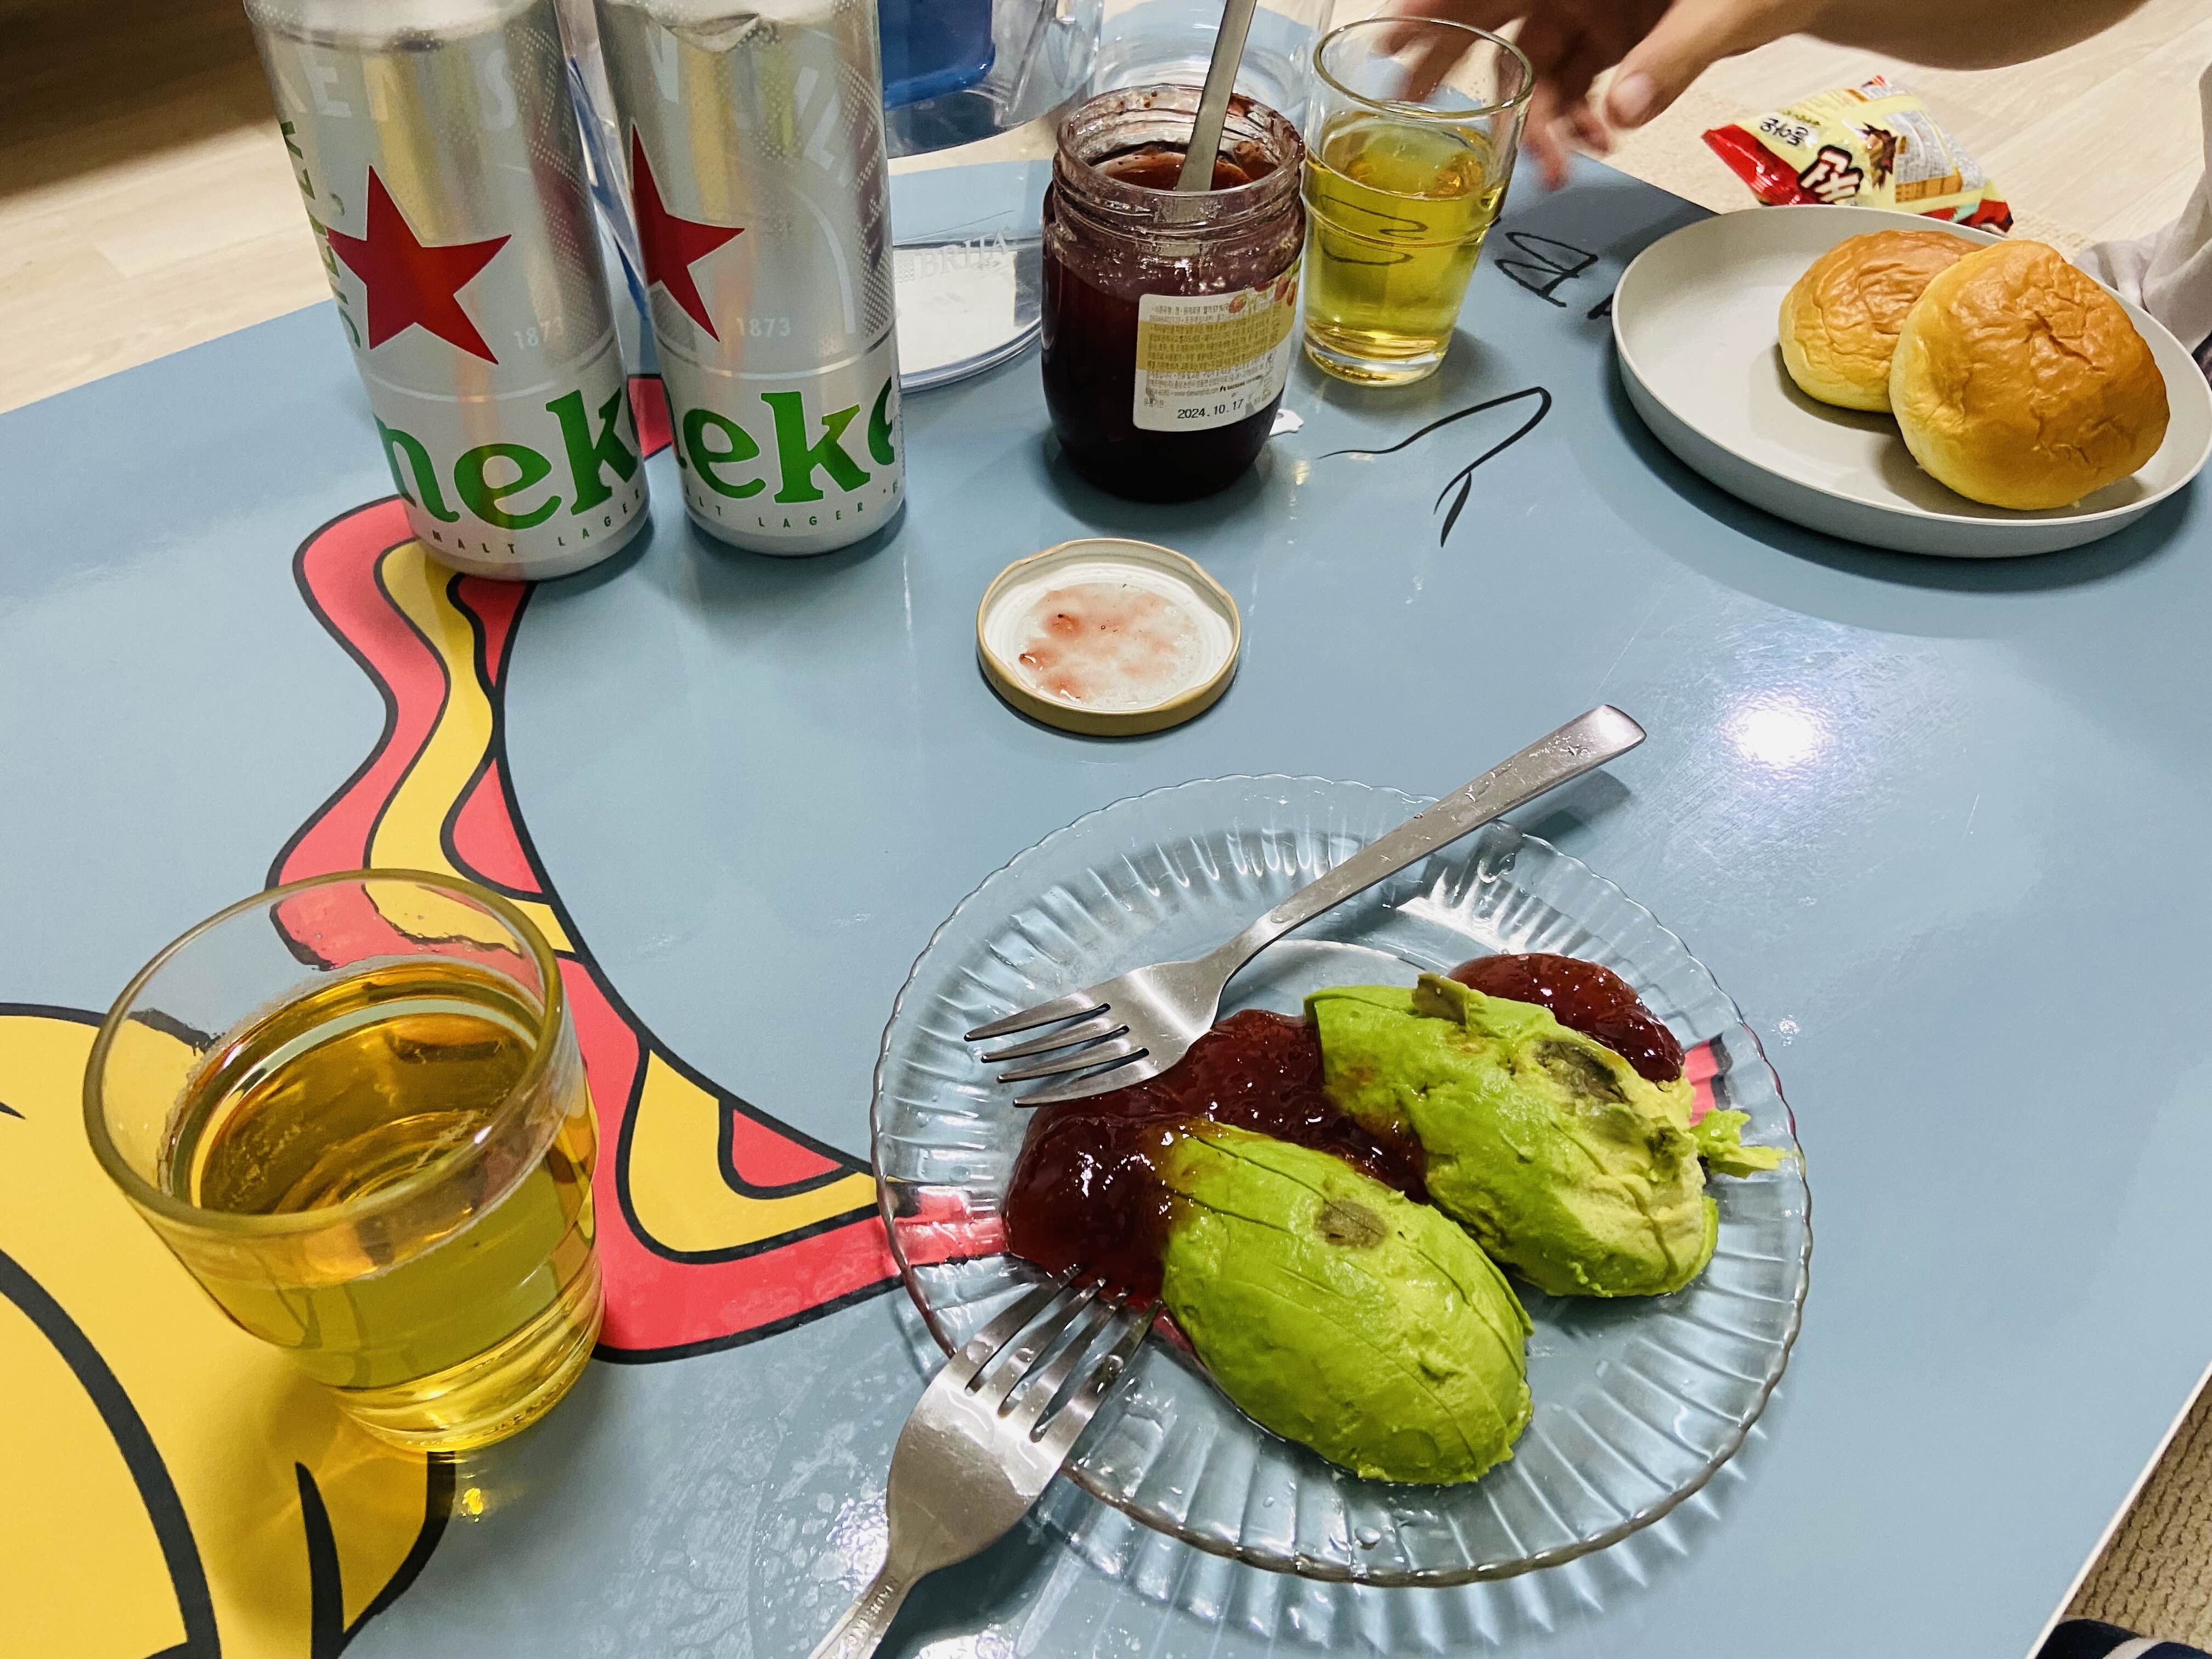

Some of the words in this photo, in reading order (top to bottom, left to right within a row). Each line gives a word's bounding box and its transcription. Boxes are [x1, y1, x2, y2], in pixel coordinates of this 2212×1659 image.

[513, 316, 566, 351] 1873
[736, 316, 792, 338] 1873
[373, 387, 641, 530] nek
[758, 501, 864, 528] LAGER
[432, 529, 516, 555] MALT
